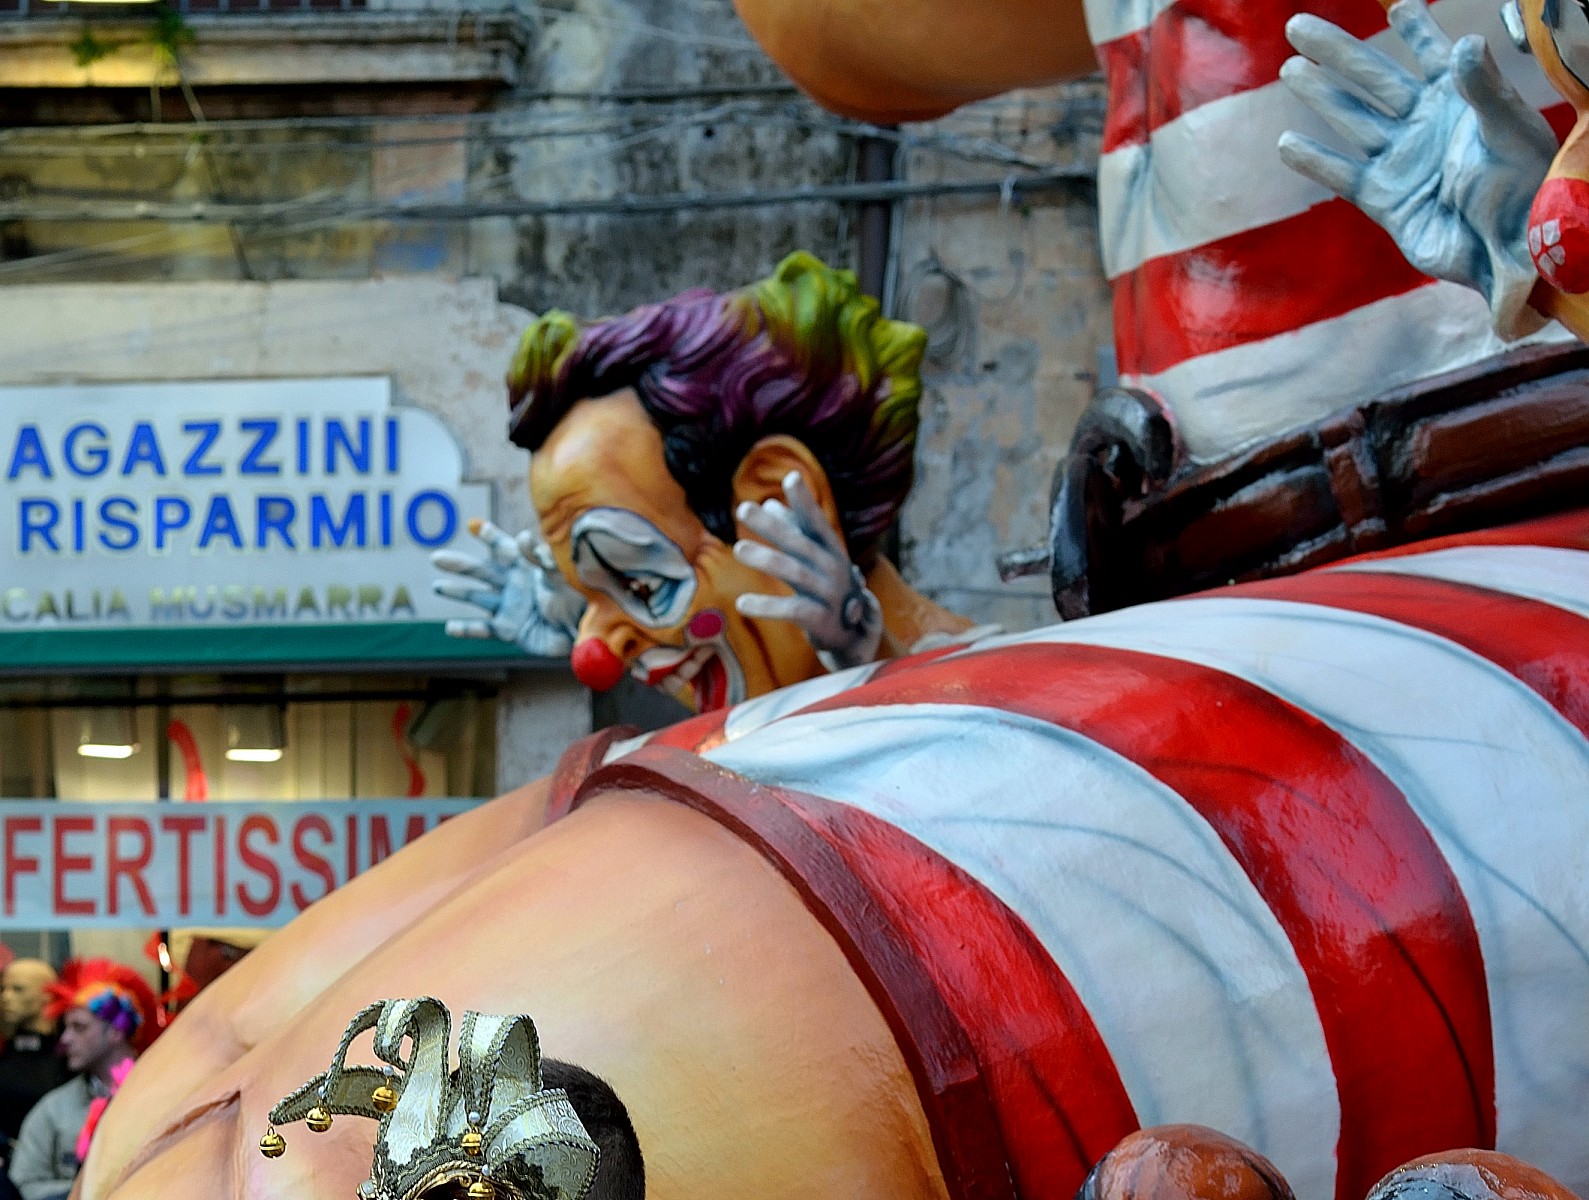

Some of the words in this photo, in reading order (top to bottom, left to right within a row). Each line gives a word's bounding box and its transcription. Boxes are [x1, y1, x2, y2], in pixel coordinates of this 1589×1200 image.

[8, 418, 399, 480] AGAZZINI
[20, 490, 458, 552] RISPARMIO
[150, 584, 416, 620] MUSMARRA
[3, 814, 460, 917] FERTISSI
